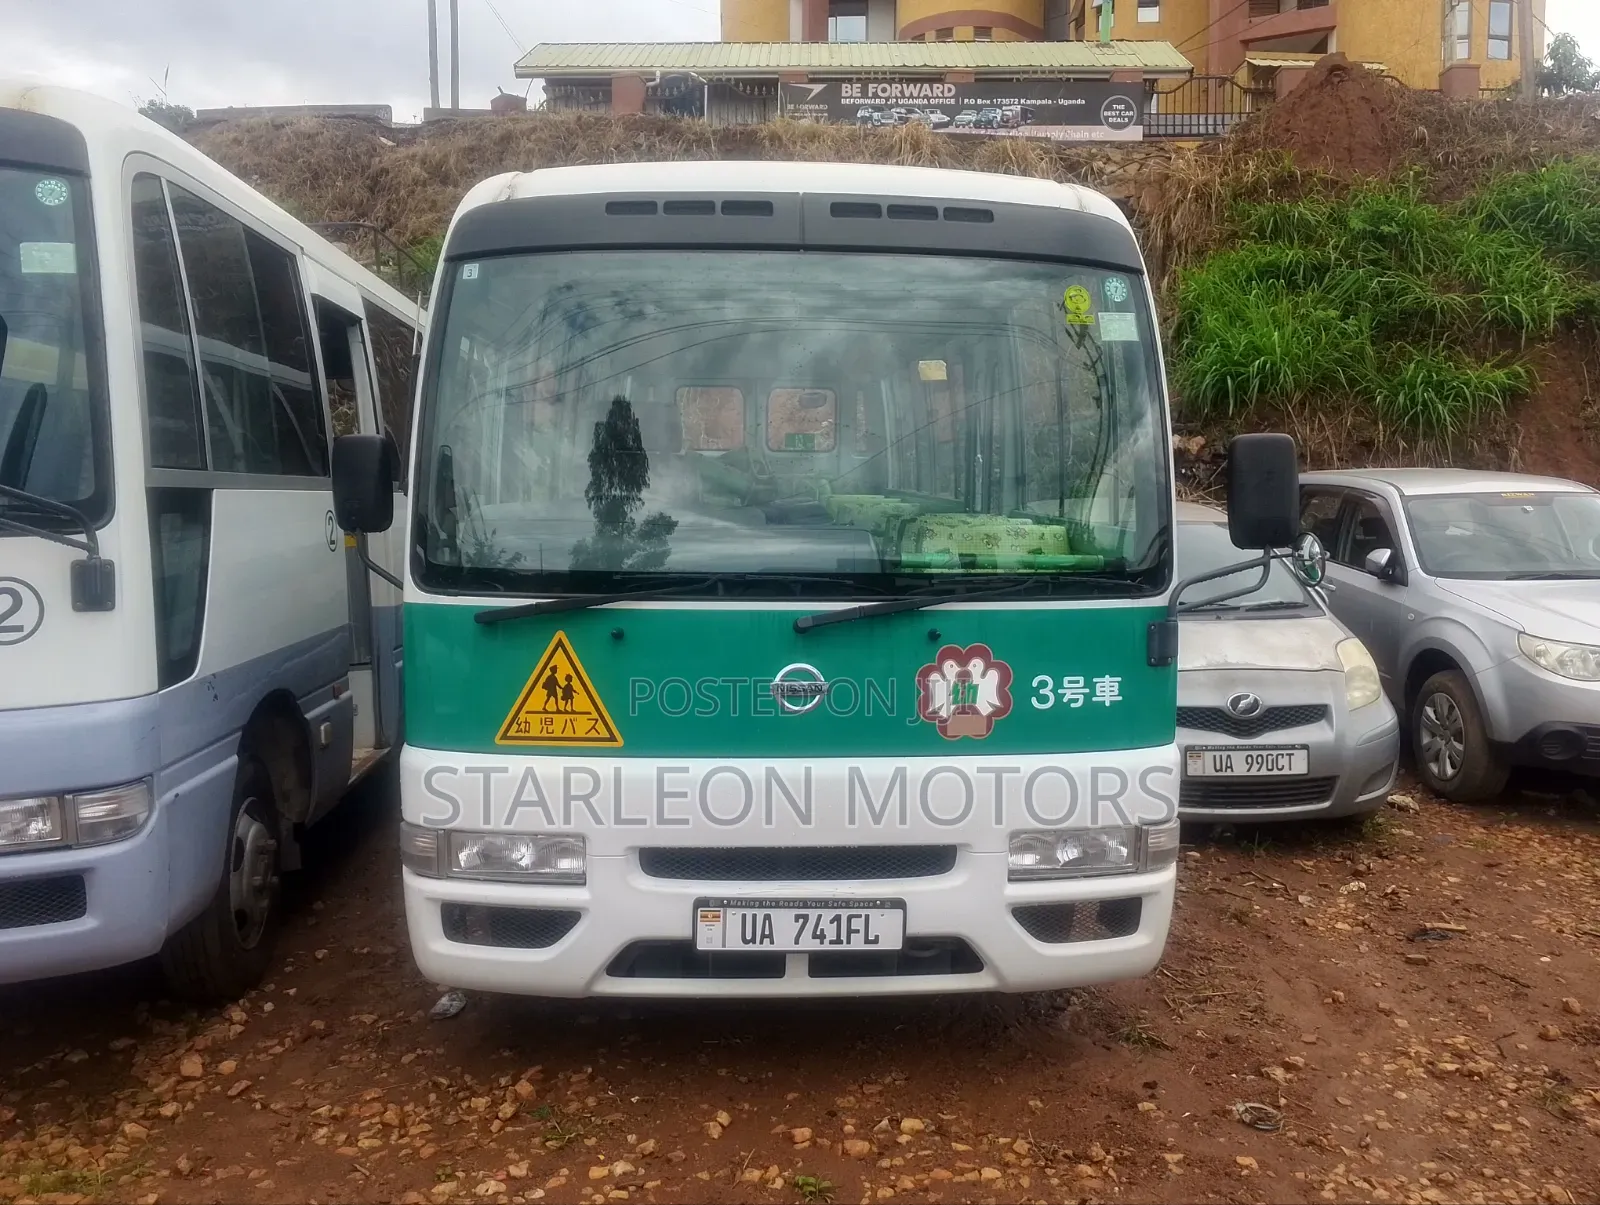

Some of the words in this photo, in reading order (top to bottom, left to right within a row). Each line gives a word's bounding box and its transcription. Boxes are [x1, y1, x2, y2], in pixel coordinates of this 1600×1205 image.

[841, 83, 862, 97] BE
[868, 83, 956, 97] FORWARD
[1020, 98, 1052, 106] Kampala
[1058, 98, 1086, 106] Uganda
[467, 268, 473, 277] 3
[776, 683, 823, 692] NISSAN
[1031, 674, 1123, 710] 3号車
[514, 716, 601, 735] 幼児バス
[1213, 754, 1234, 773] UA
[740, 913, 775, 945] UA
[793, 913, 880, 945] 741FL
